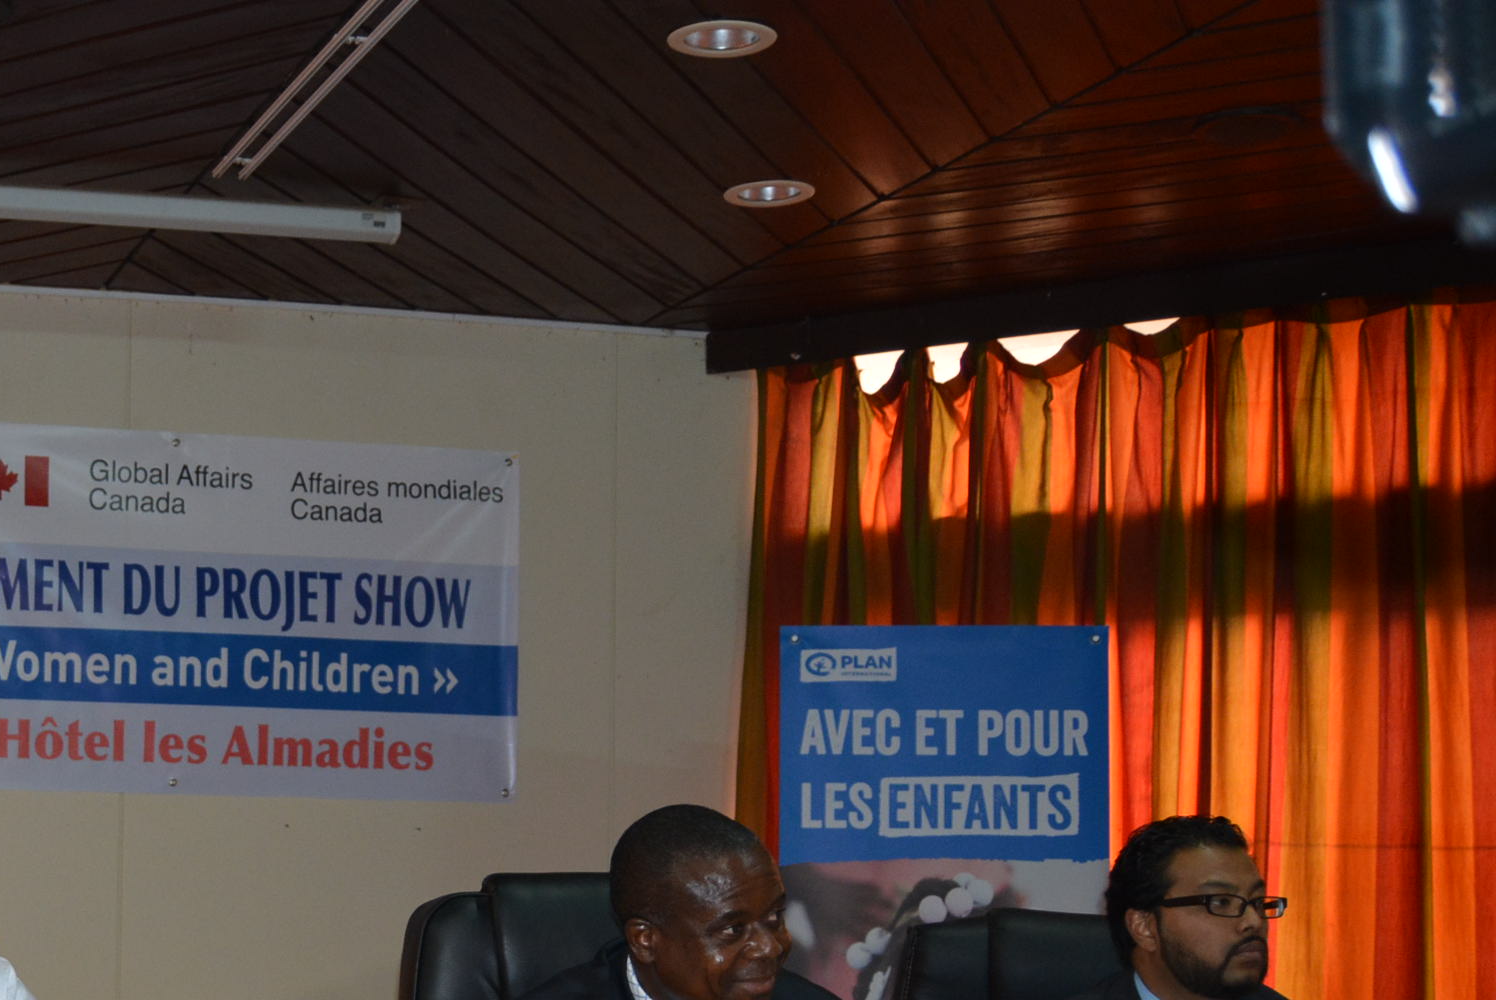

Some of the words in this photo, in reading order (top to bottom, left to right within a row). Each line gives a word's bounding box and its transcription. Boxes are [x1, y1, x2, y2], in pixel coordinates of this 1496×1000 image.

[89, 459, 170, 487] Global
[177, 464, 253, 490] Affairs
[291, 471, 379, 498] Affaires
[387, 479, 504, 504] mondiales
[89, 487, 186, 515] Canada
[291, 500, 383, 524] Canada
[123, 563, 182, 617] DU
[195, 566, 343, 632] PROJET
[354, 572, 471, 629] SHOW
[151, 647, 228, 688] and
[243, 649, 420, 695] Children
[841, 655, 892, 669] PLAN
[143, 720, 208, 764] les
[221, 724, 434, 771] Almadies
[800, 708, 901, 756] AVEC
[915, 709, 964, 756] ET
[978, 709, 1089, 757] POUR
[801, 782, 873, 829] LES
[889, 783, 1072, 831] ENFANTS
